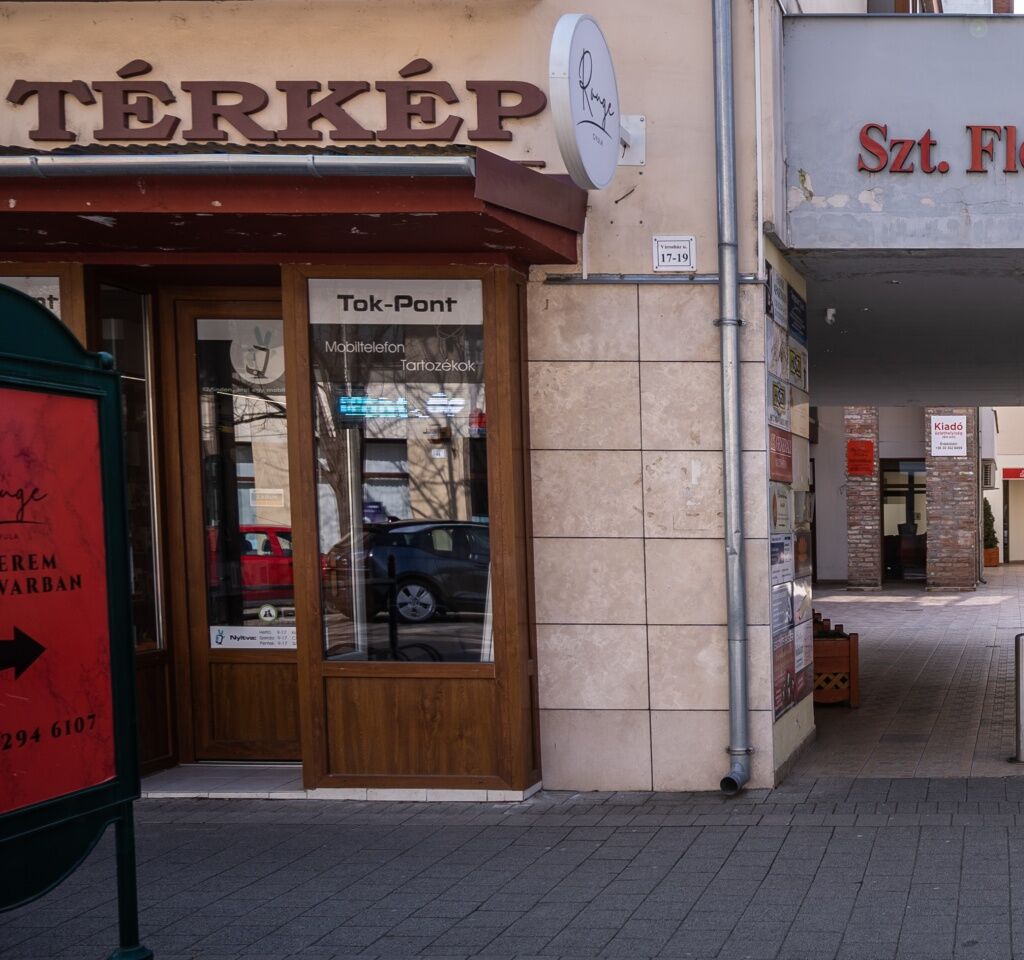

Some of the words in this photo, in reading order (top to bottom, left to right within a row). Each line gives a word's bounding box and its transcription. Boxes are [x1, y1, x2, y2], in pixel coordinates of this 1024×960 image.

[6, 57, 548, 142] TÉRKÉP
[857, 122, 950, 174] Szt.
[661, 253, 689, 263] 17-19
[337, 294, 458, 312] Tok-Pont
[325, 340, 405, 354] Mobiltelefon
[400, 358, 476, 372] Tartozékok
[934, 421, 963, 431] Kiadó
[1, 726, 41, 752] 294
[50, 712, 97, 740] 6107
